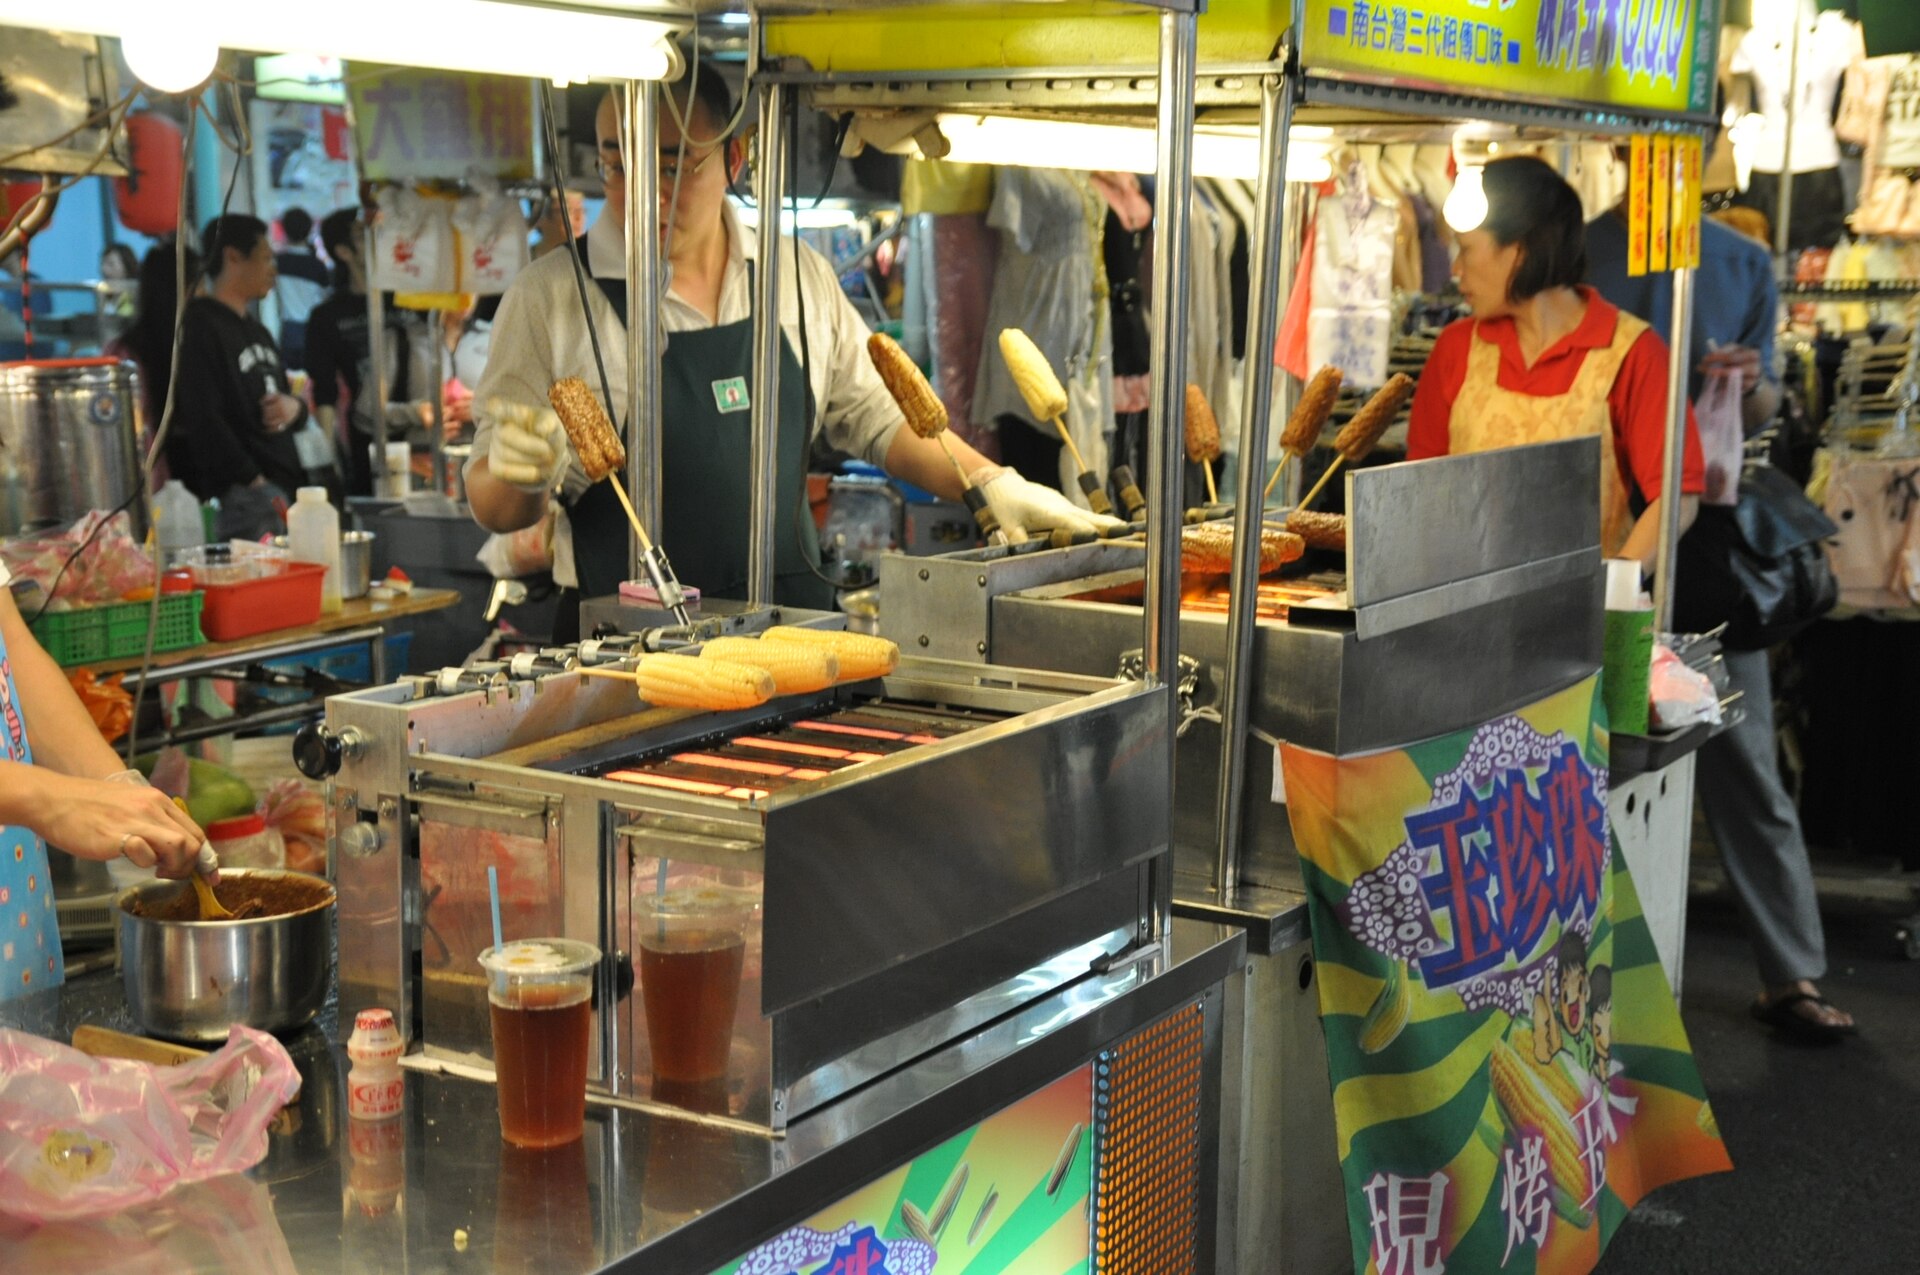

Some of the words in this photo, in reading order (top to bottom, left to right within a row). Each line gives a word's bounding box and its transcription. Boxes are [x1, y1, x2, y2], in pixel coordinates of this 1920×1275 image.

[1350, 0, 1504, 67] 南台灣三代祖傳口味
